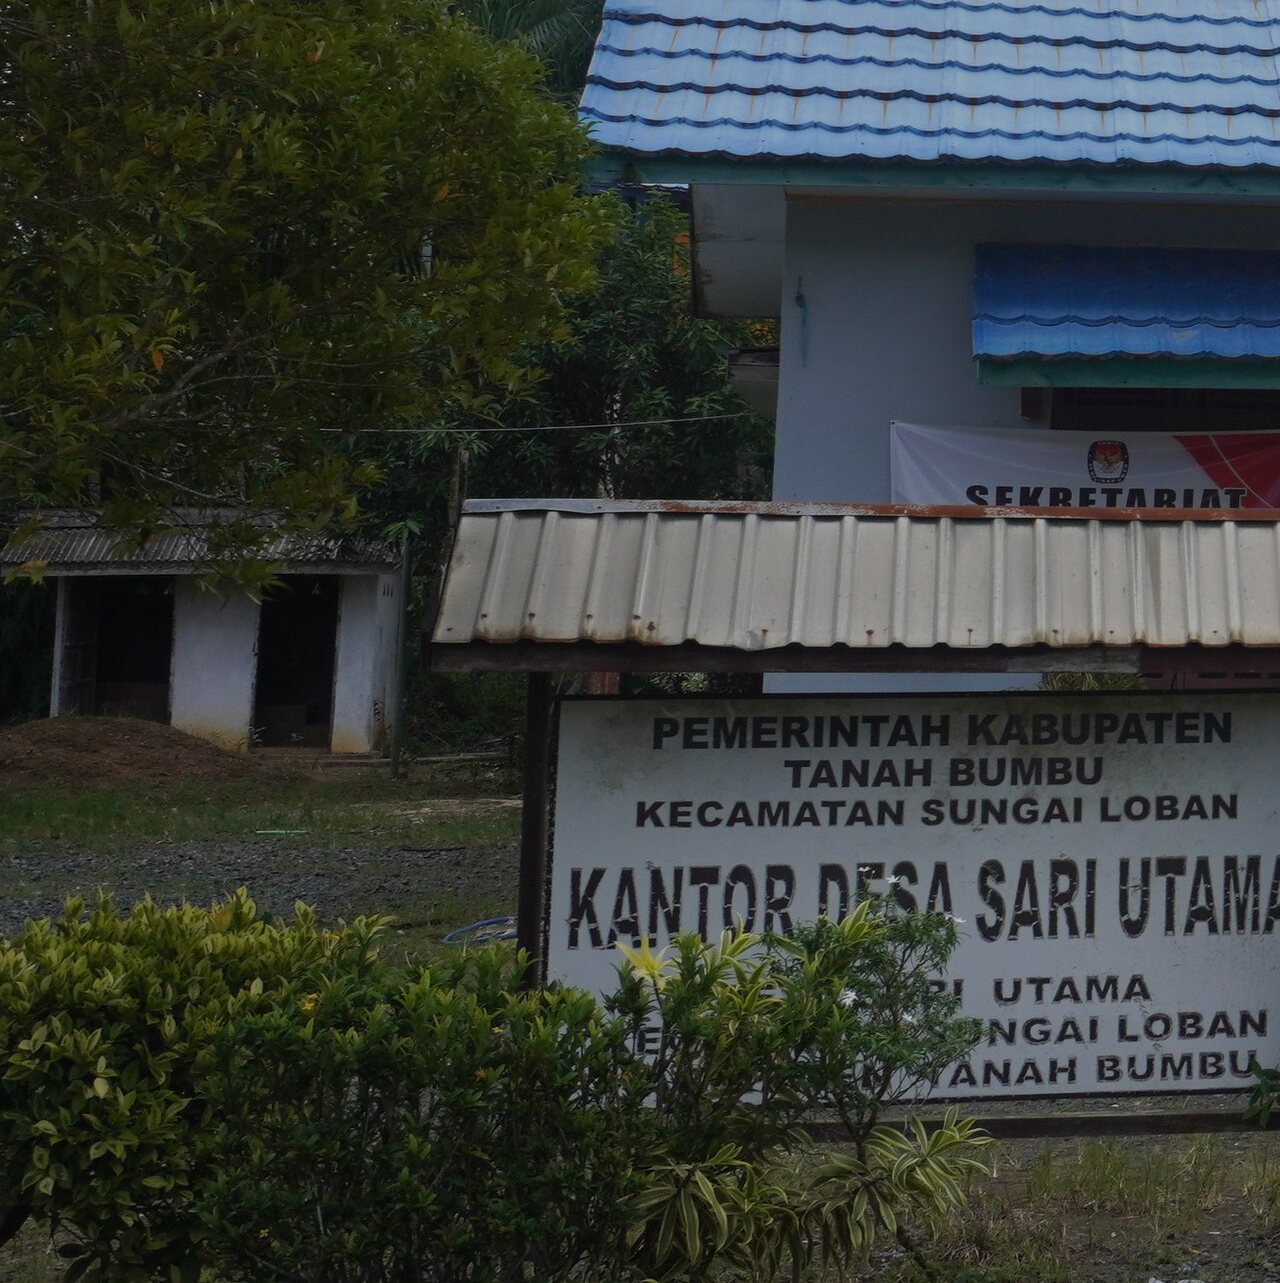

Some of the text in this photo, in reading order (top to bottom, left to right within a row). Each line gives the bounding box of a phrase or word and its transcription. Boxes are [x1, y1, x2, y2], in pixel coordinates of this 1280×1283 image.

[965, 485, 1248, 508] SEKRETARIAT
[653, 711, 1234, 751] PEMERINTAH KABUPATEN
[784, 755, 1104, 789] TANAH BUMBU
[635, 793, 1240, 828] KECAMATAN SUNGAI LOBAN
[566, 862, 798, 952] KANTOR
[975, 857, 1098, 943] SARI
[992, 973, 1154, 1006] UTAMA
[970, 1008, 1269, 1046] NGAI LOBAN
[1096, 1047, 1258, 1083] BUMBU
